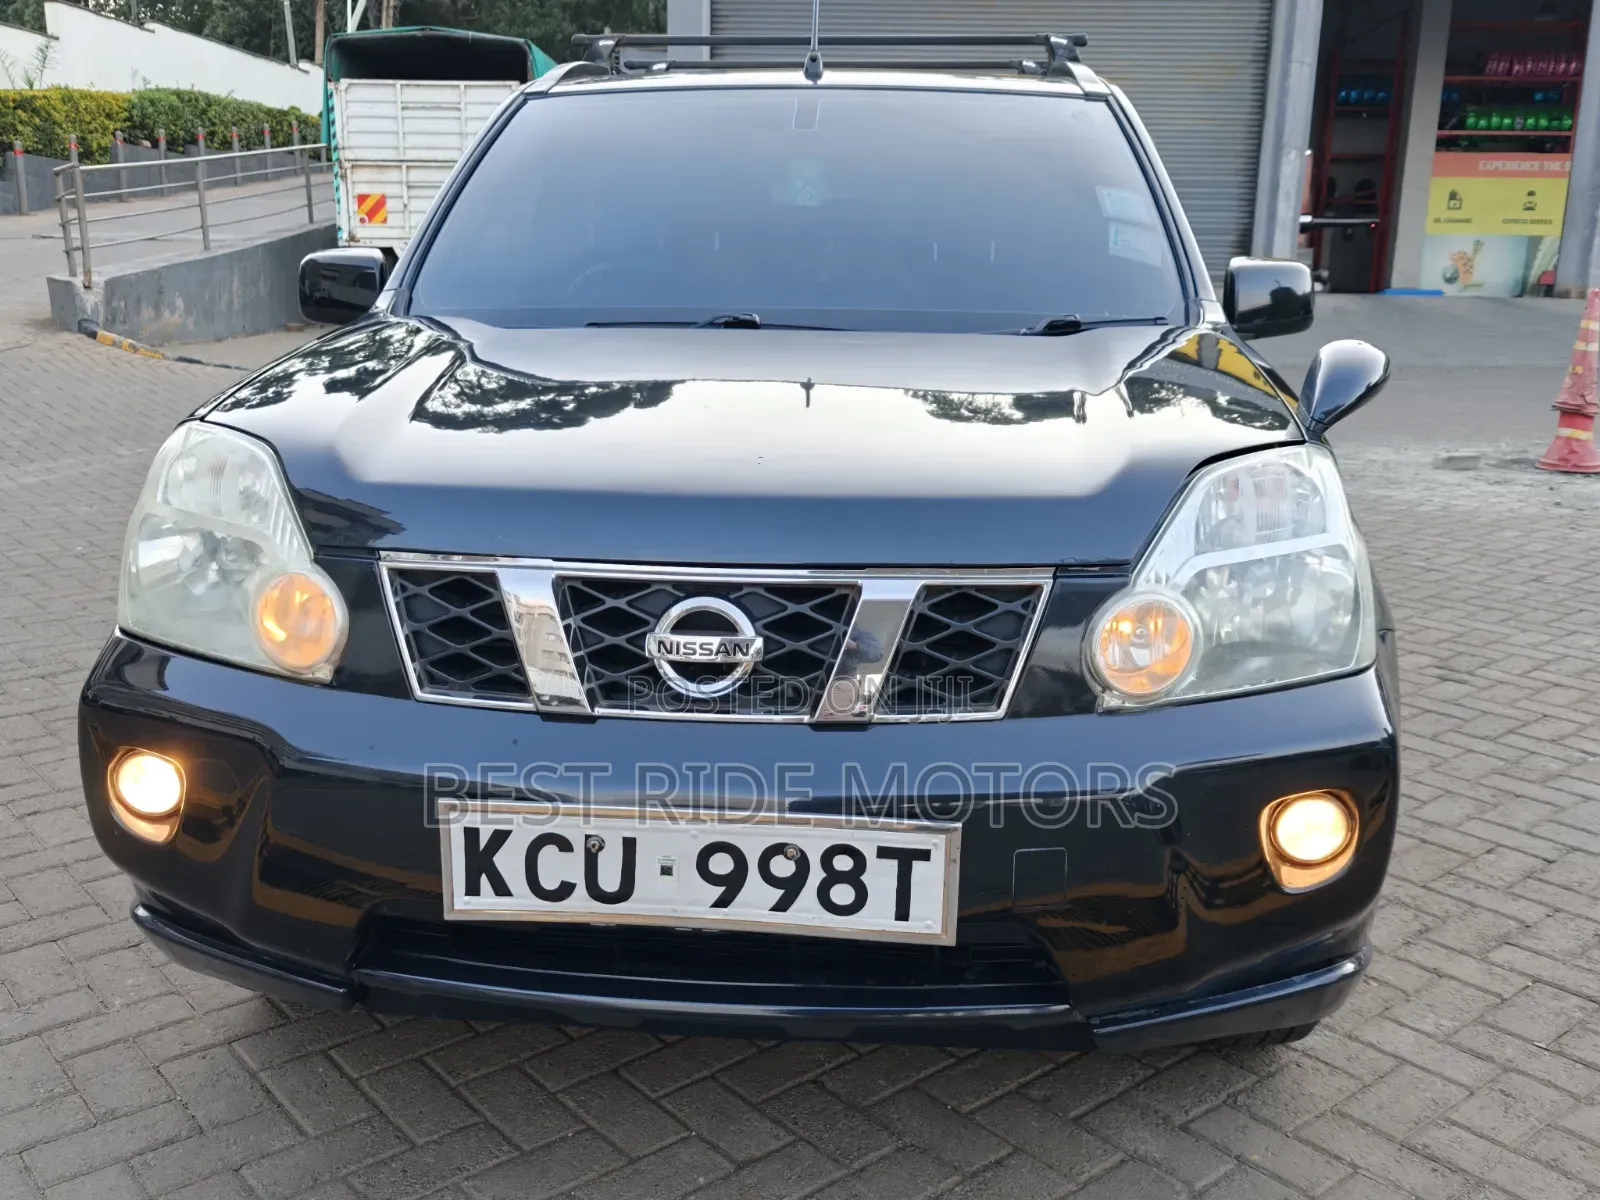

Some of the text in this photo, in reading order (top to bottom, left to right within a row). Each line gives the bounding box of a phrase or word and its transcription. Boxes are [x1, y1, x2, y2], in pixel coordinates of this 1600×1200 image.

[1479, 160, 1541, 171] EXPERIENCE
[1543, 161, 1563, 171] THE
[657, 639, 751, 657] NISSAN
[463, 826, 932, 922] KCU 998T
